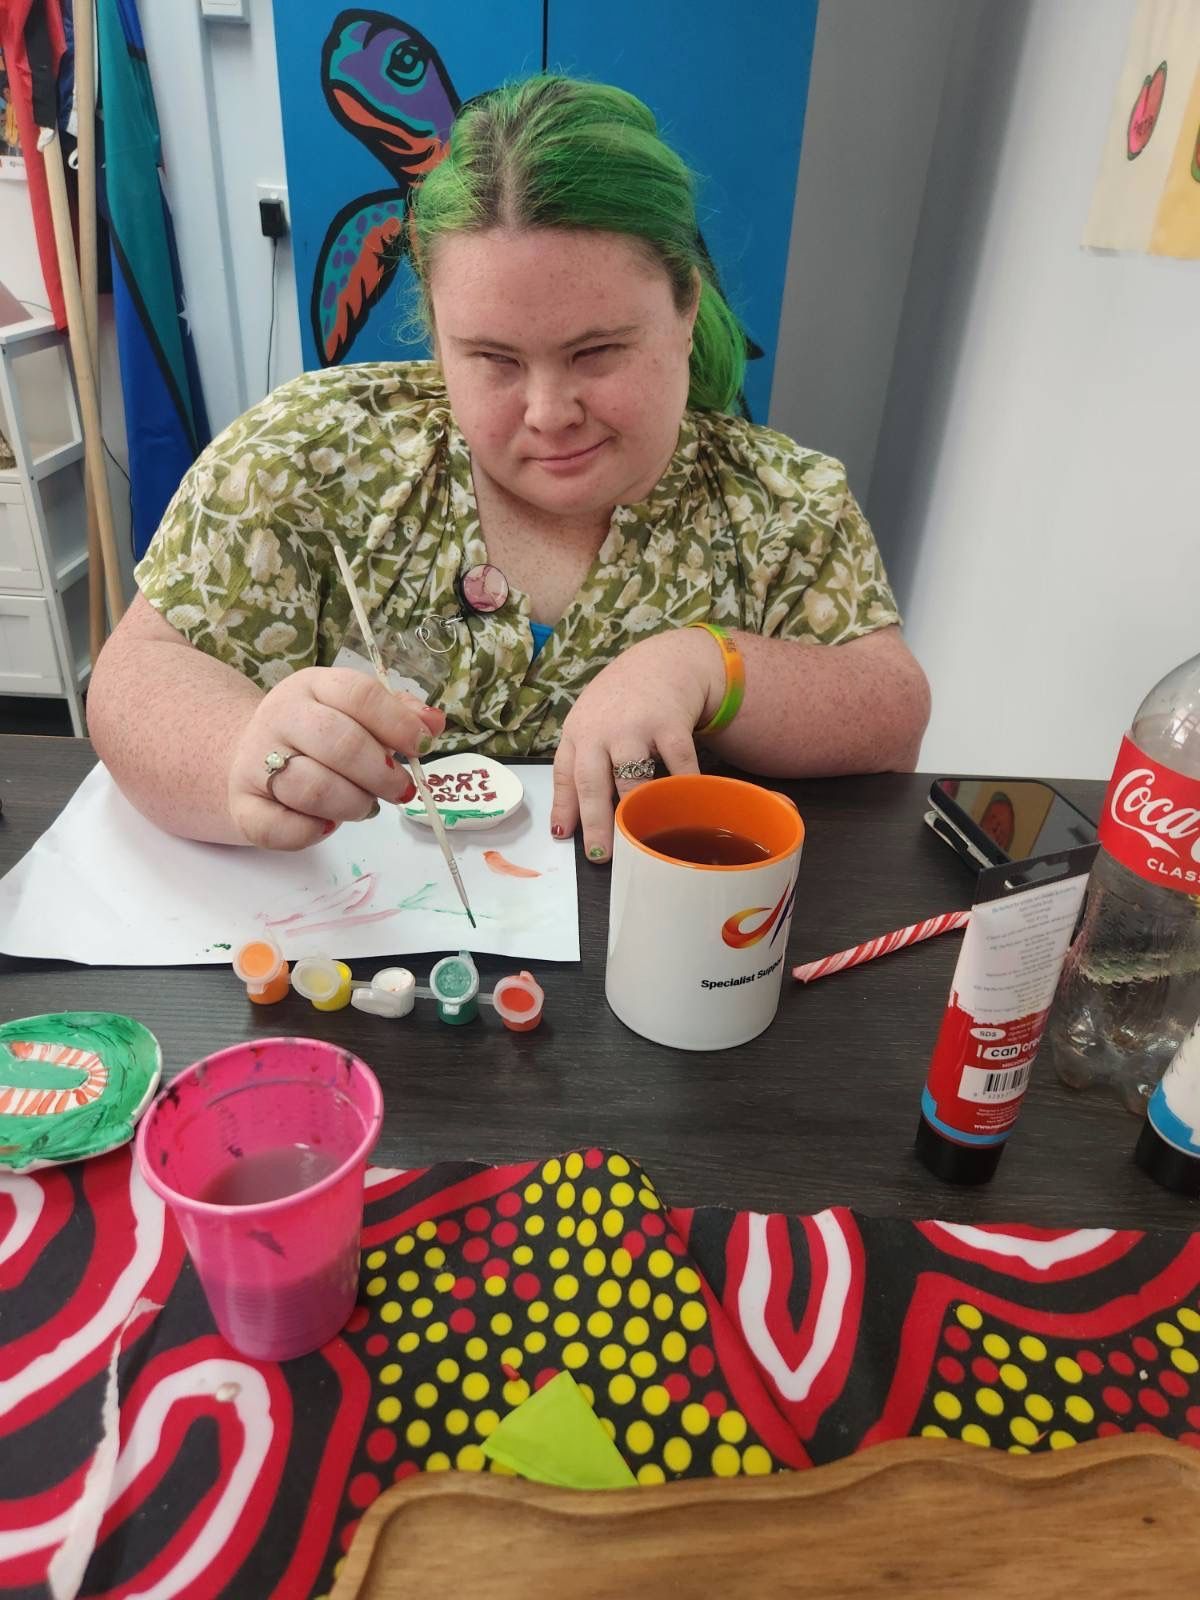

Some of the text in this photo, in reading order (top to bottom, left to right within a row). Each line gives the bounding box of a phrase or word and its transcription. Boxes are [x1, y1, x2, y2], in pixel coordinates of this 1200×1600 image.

[1146, 857, 1200, 884] CLAS
[700, 973, 756, 990] Specialist
[990, 1045, 1019, 1057] can
